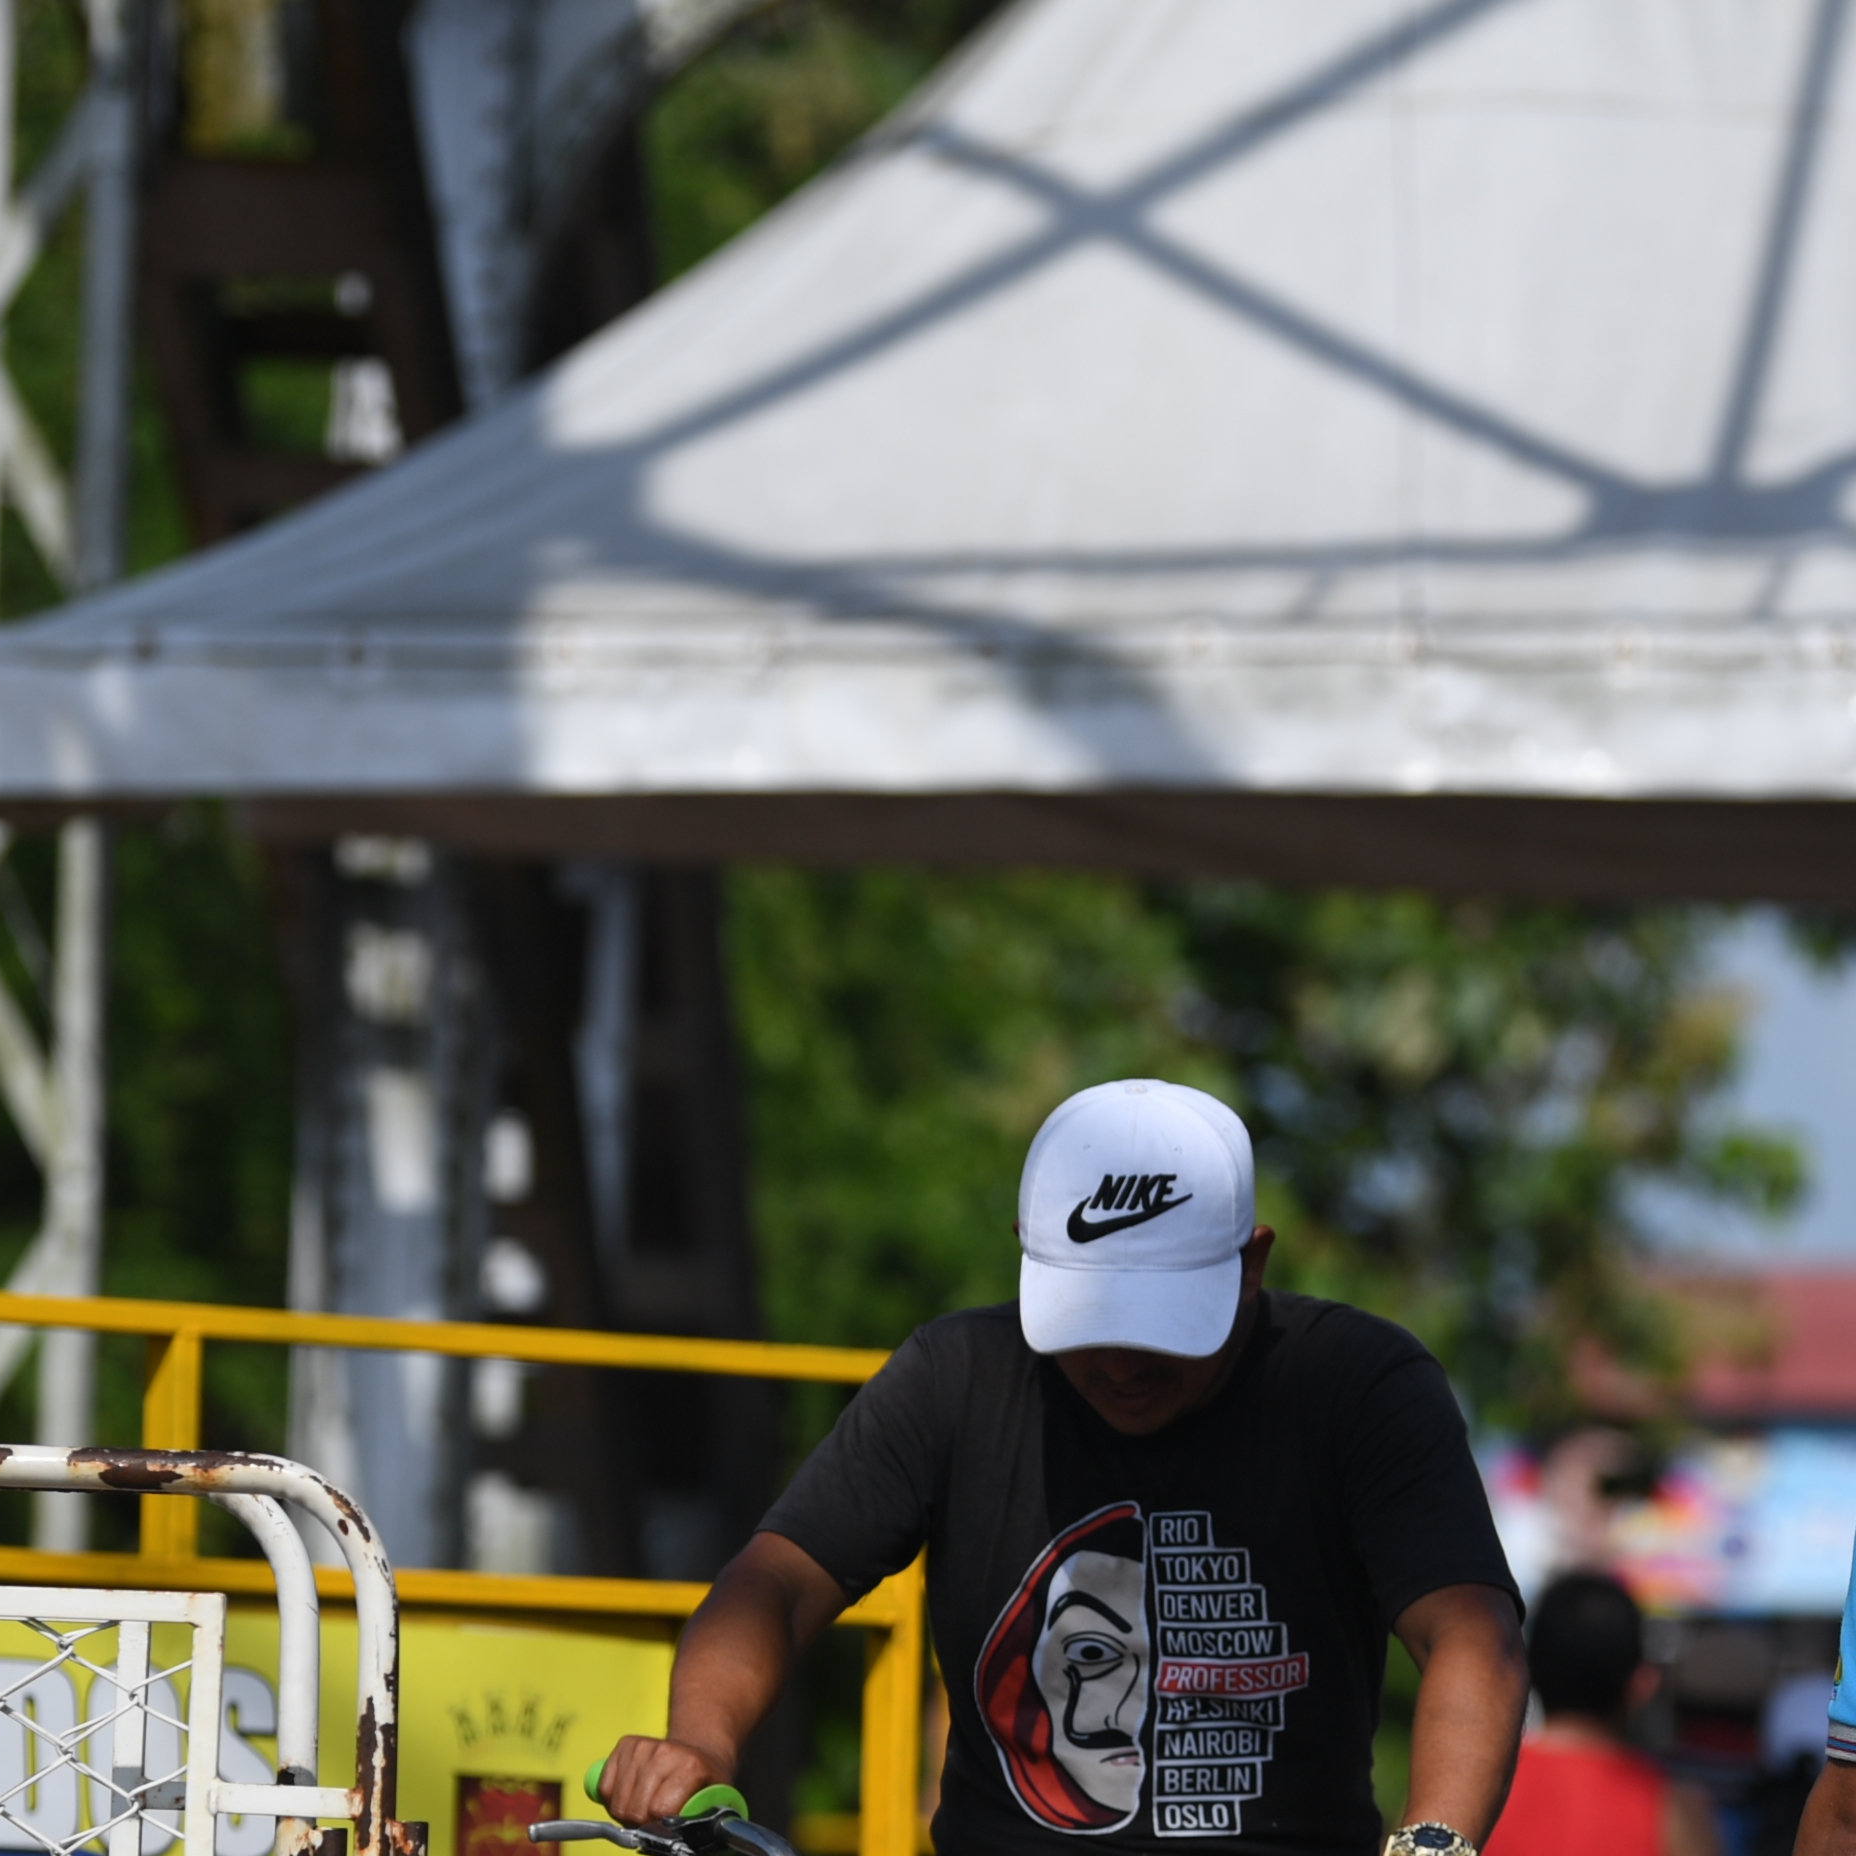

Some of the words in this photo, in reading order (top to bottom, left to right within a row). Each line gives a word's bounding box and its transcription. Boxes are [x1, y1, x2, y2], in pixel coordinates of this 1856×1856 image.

[1089, 1173, 1177, 1211] NIKE
[1160, 1517, 1199, 1543] RIO
[1161, 1555, 1239, 1582] TOKYO
[1163, 1592, 1256, 1619] DENVER
[1166, 1629, 1274, 1656] MOSCOW
[1162, 1662, 1301, 1691] PROFESSOR
[1166, 1699, 1273, 1723] HELSINKI
[1164, 1730, 1261, 1757] NAIROBI
[1163, 1766, 1251, 1793] BERLIN
[1164, 1803, 1230, 1829] OSLO
